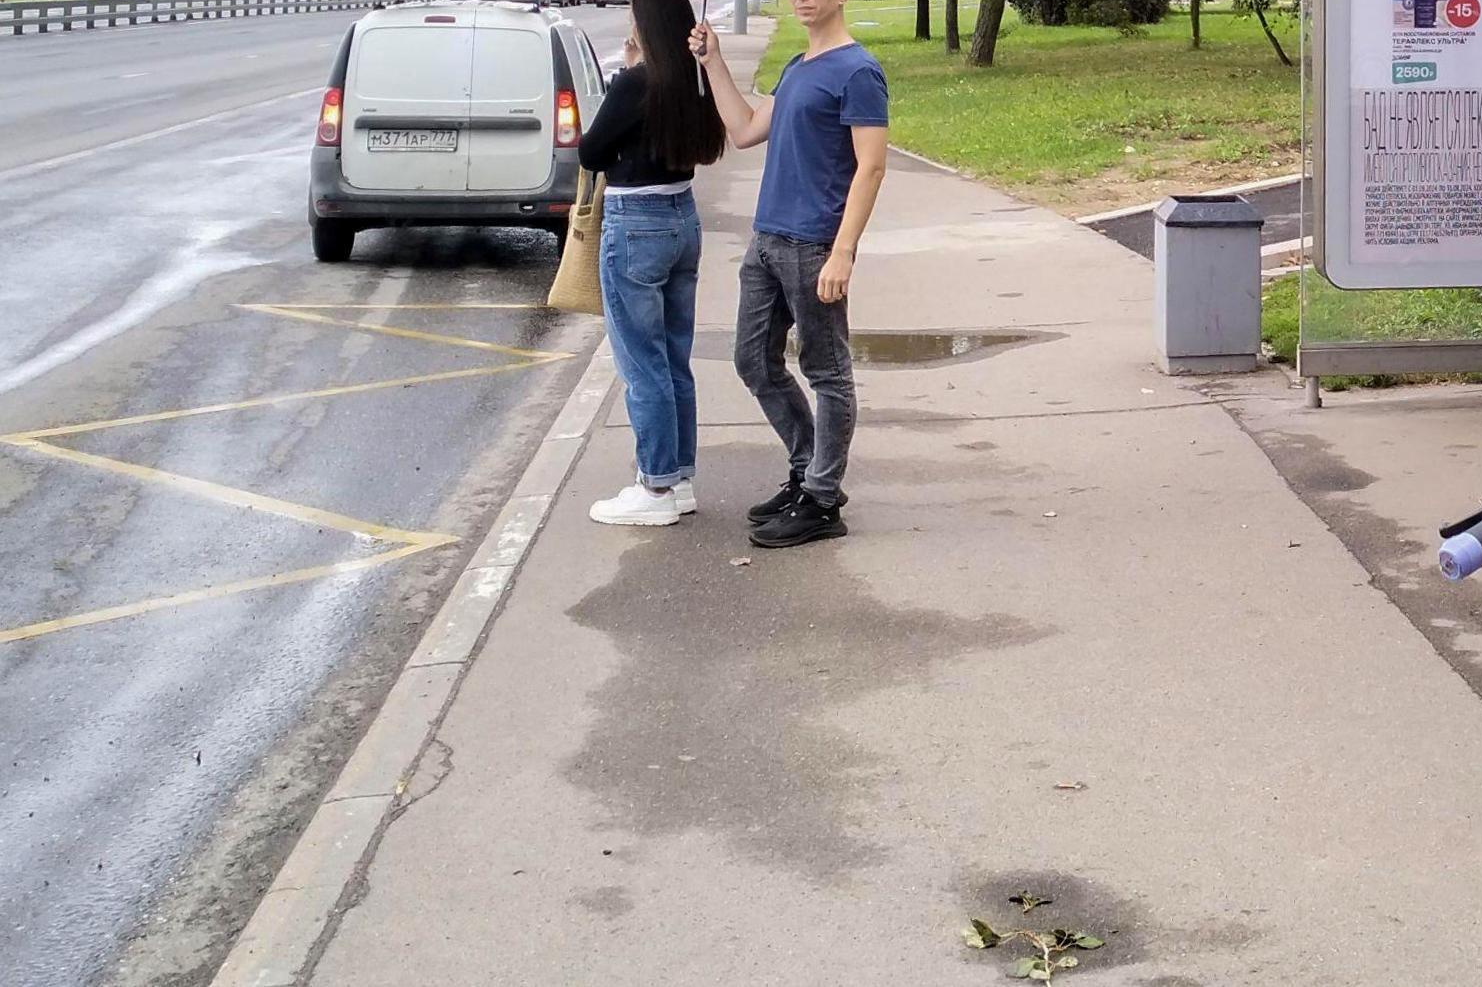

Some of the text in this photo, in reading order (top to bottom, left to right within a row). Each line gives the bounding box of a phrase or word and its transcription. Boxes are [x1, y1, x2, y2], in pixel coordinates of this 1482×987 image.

[1363, 91, 1387, 153] БАД
[1389, 91, 1403, 150] НЕ
[1406, 90, 1461, 150] ЯВЛЯЕТСЯ
